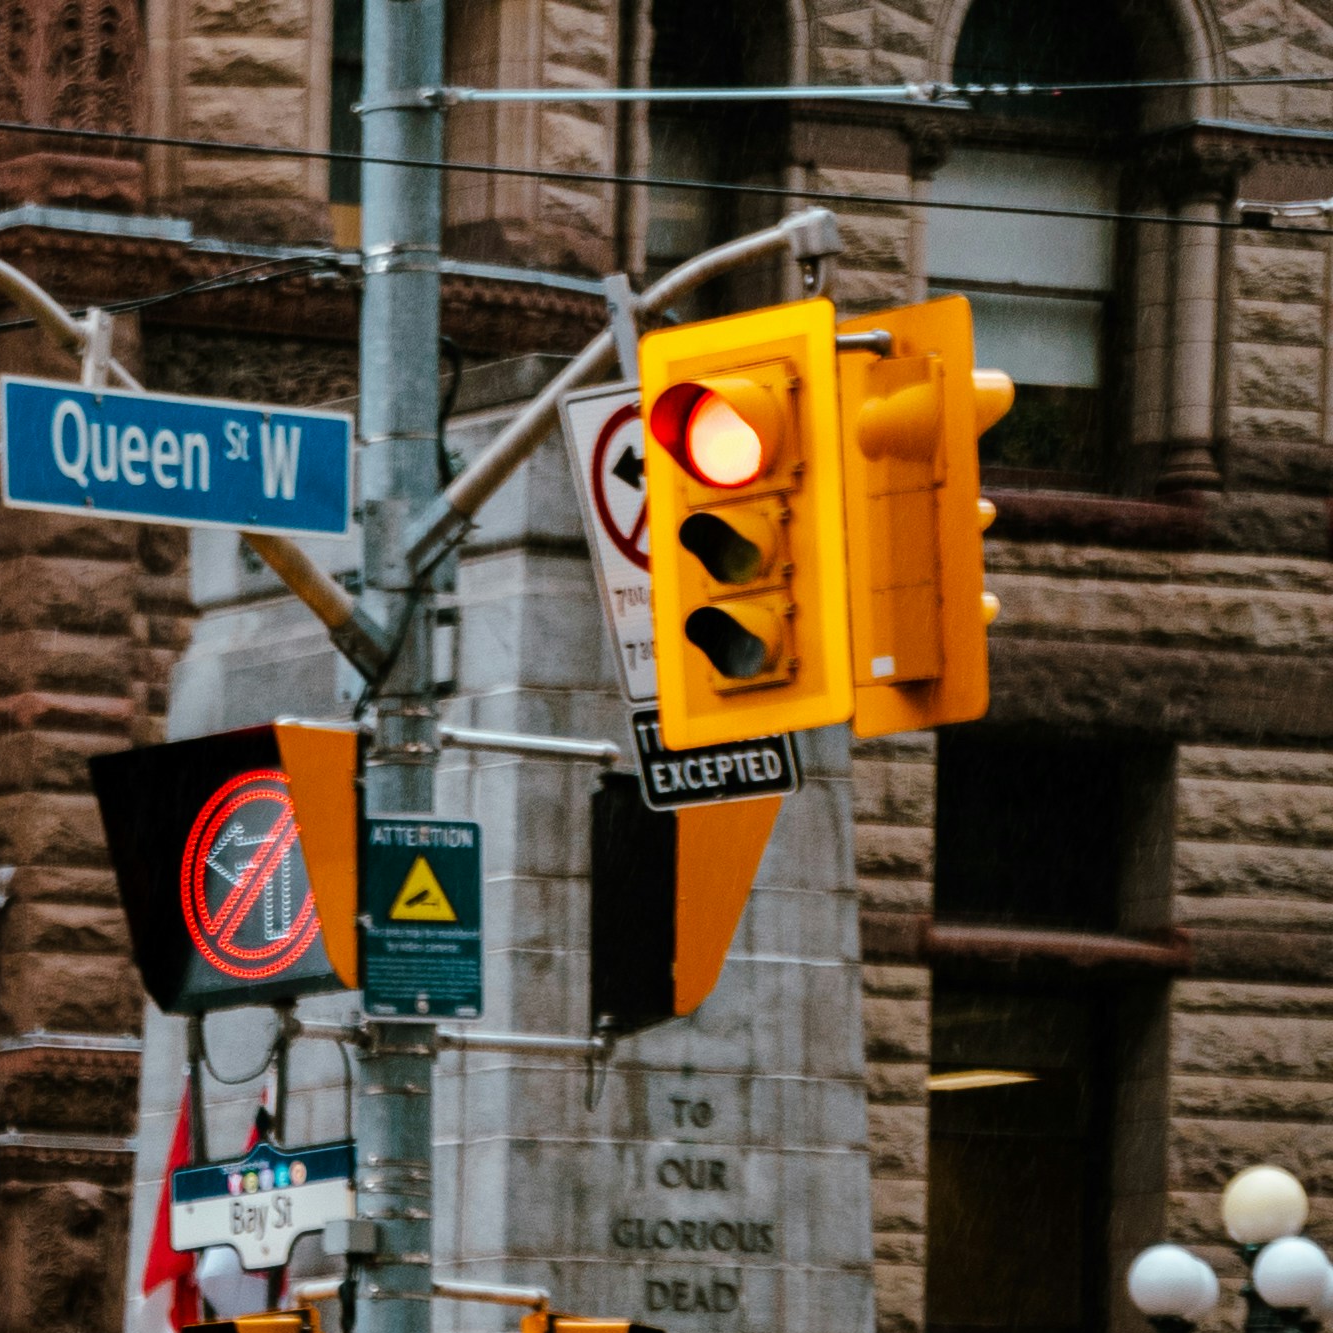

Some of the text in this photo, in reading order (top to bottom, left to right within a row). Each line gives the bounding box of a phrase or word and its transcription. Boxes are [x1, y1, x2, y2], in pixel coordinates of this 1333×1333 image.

[51, 399, 302, 501] Queen St W
[650, 749, 783, 794] EXCEPTED
[668, 1096, 715, 1129] TO
[656, 1158, 730, 1191] OUR
[229, 1194, 293, 1241] Bay St
[611, 1217, 775, 1253] GLORIOUS
[645, 1279, 739, 1313] DEAD
